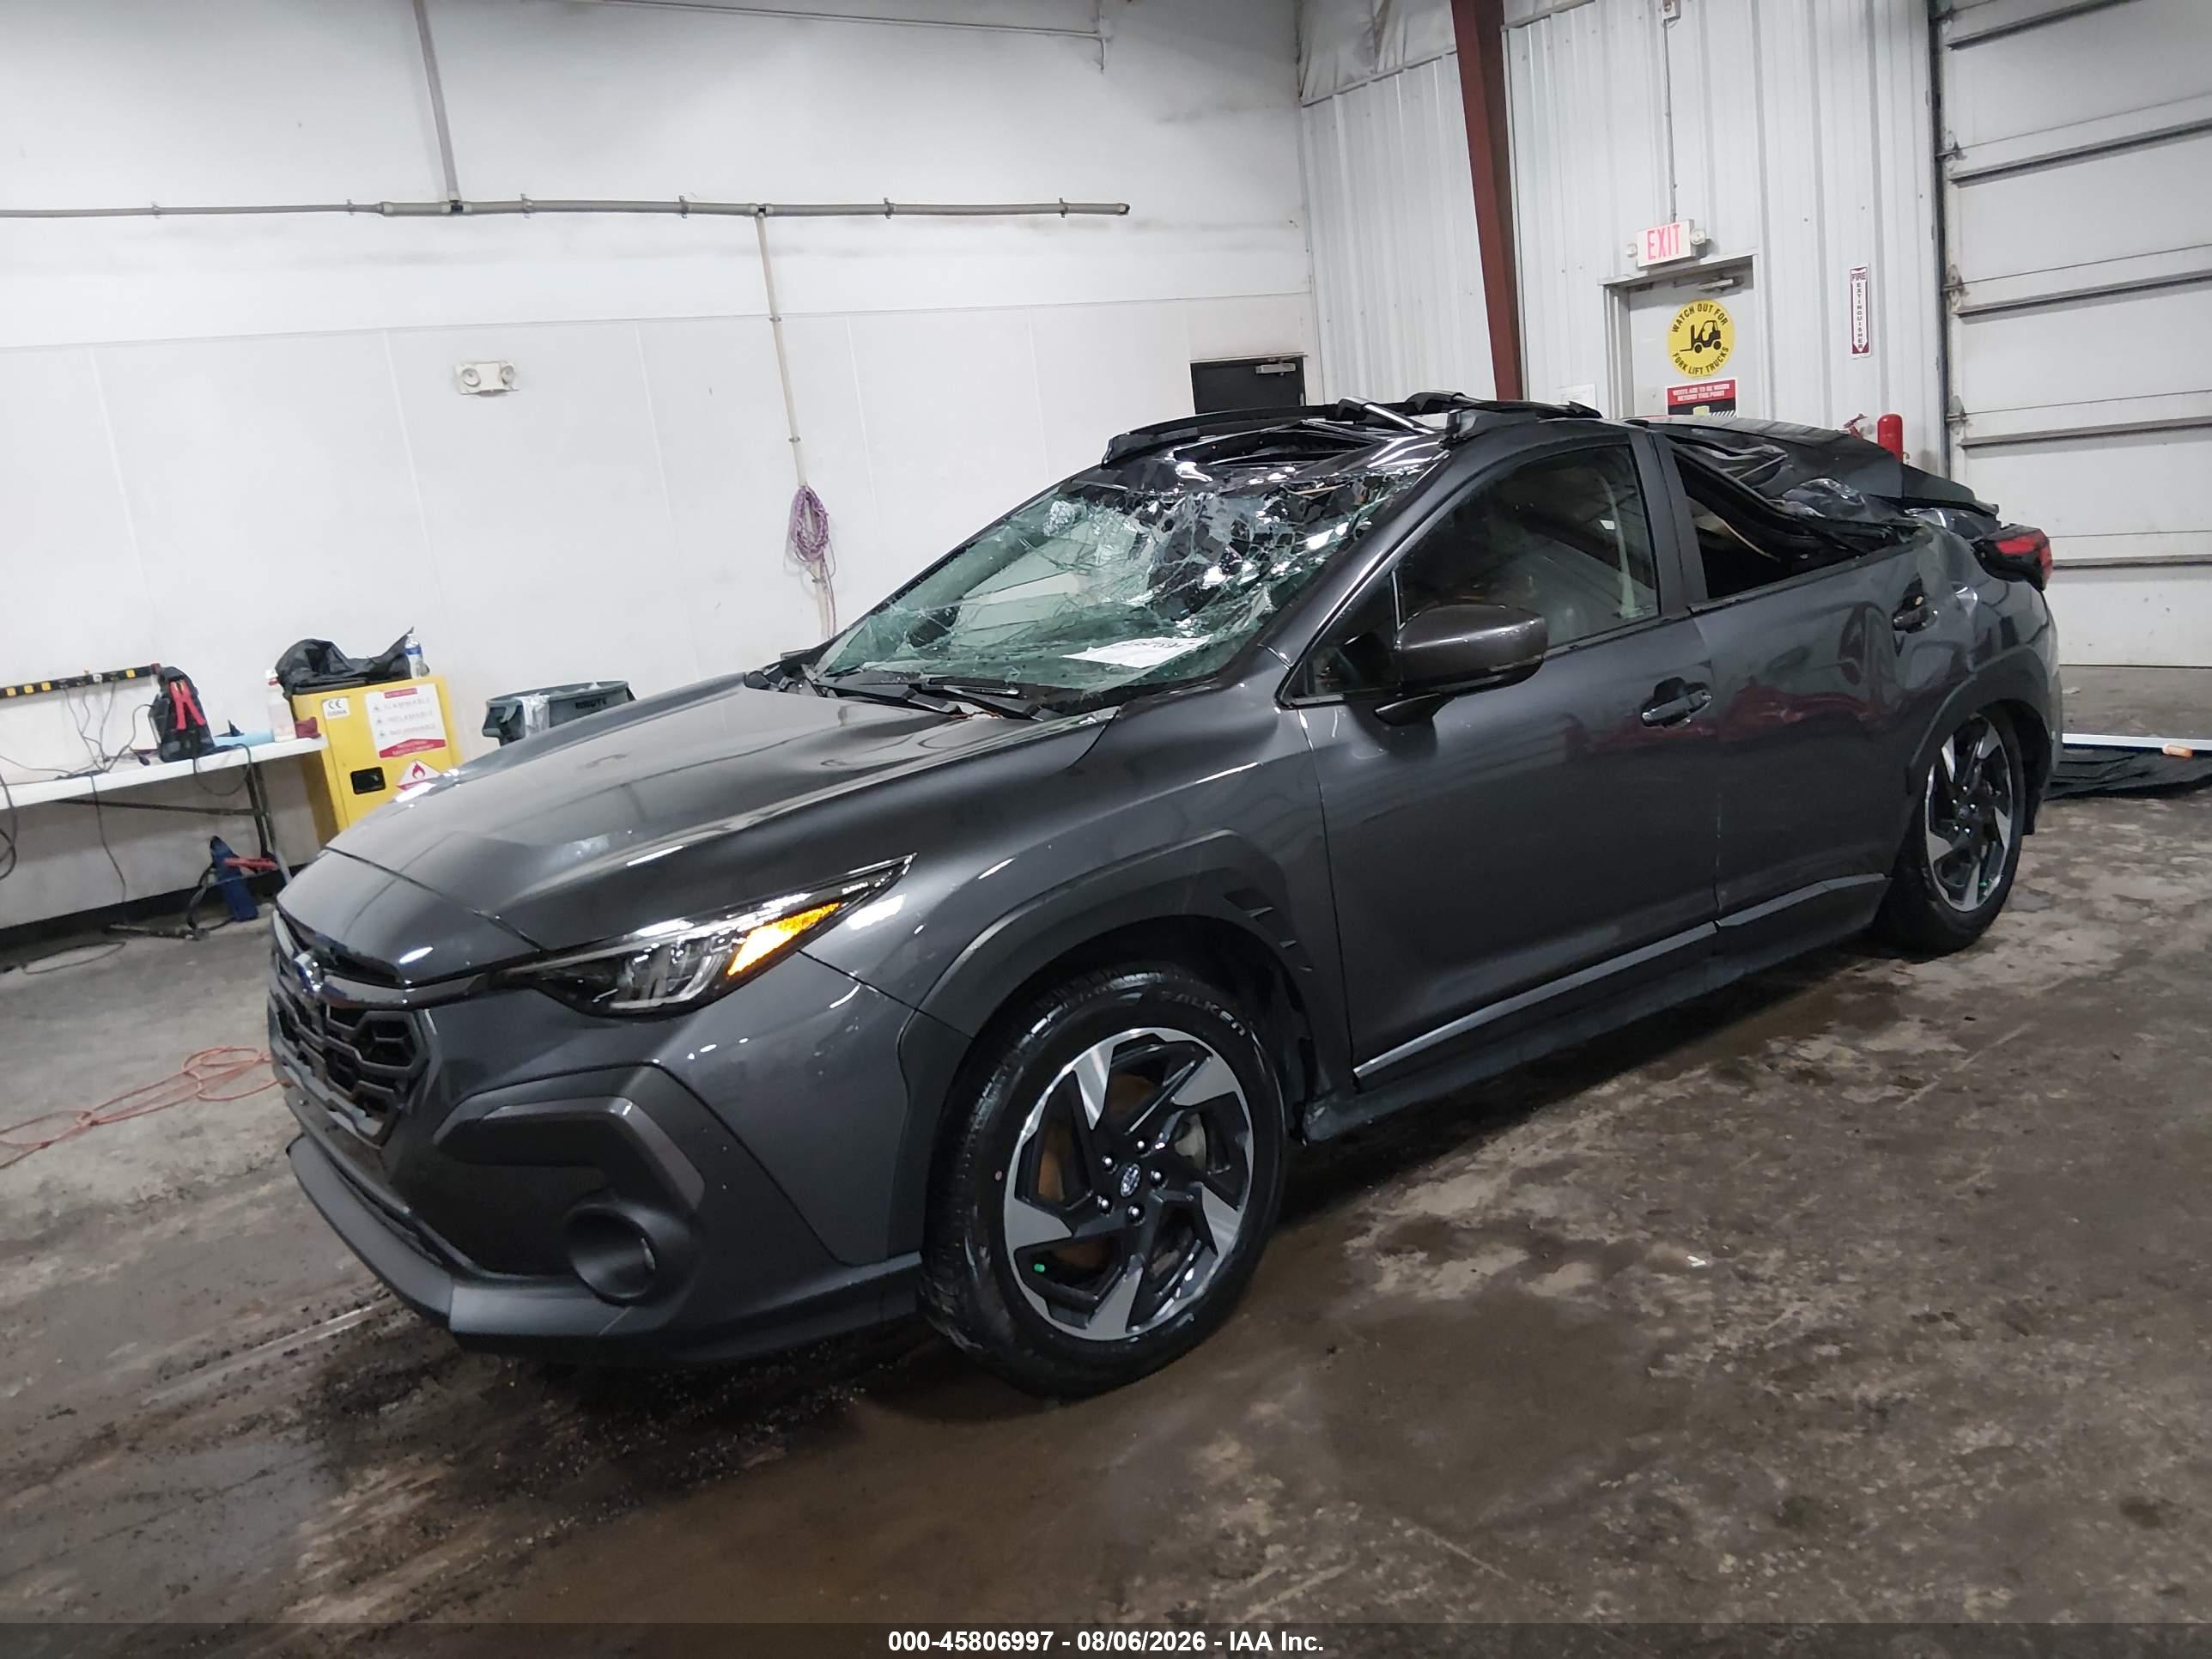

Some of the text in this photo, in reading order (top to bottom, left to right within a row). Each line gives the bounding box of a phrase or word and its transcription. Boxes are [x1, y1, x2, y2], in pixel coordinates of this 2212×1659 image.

[1647, 224, 1680, 261] EXIT
[1850, 272, 1867, 282] FIRE
[1671, 303, 1729, 333] WATCH OUT FOR
[1672, 346, 1729, 375] FORK LIFT TRUCKS
